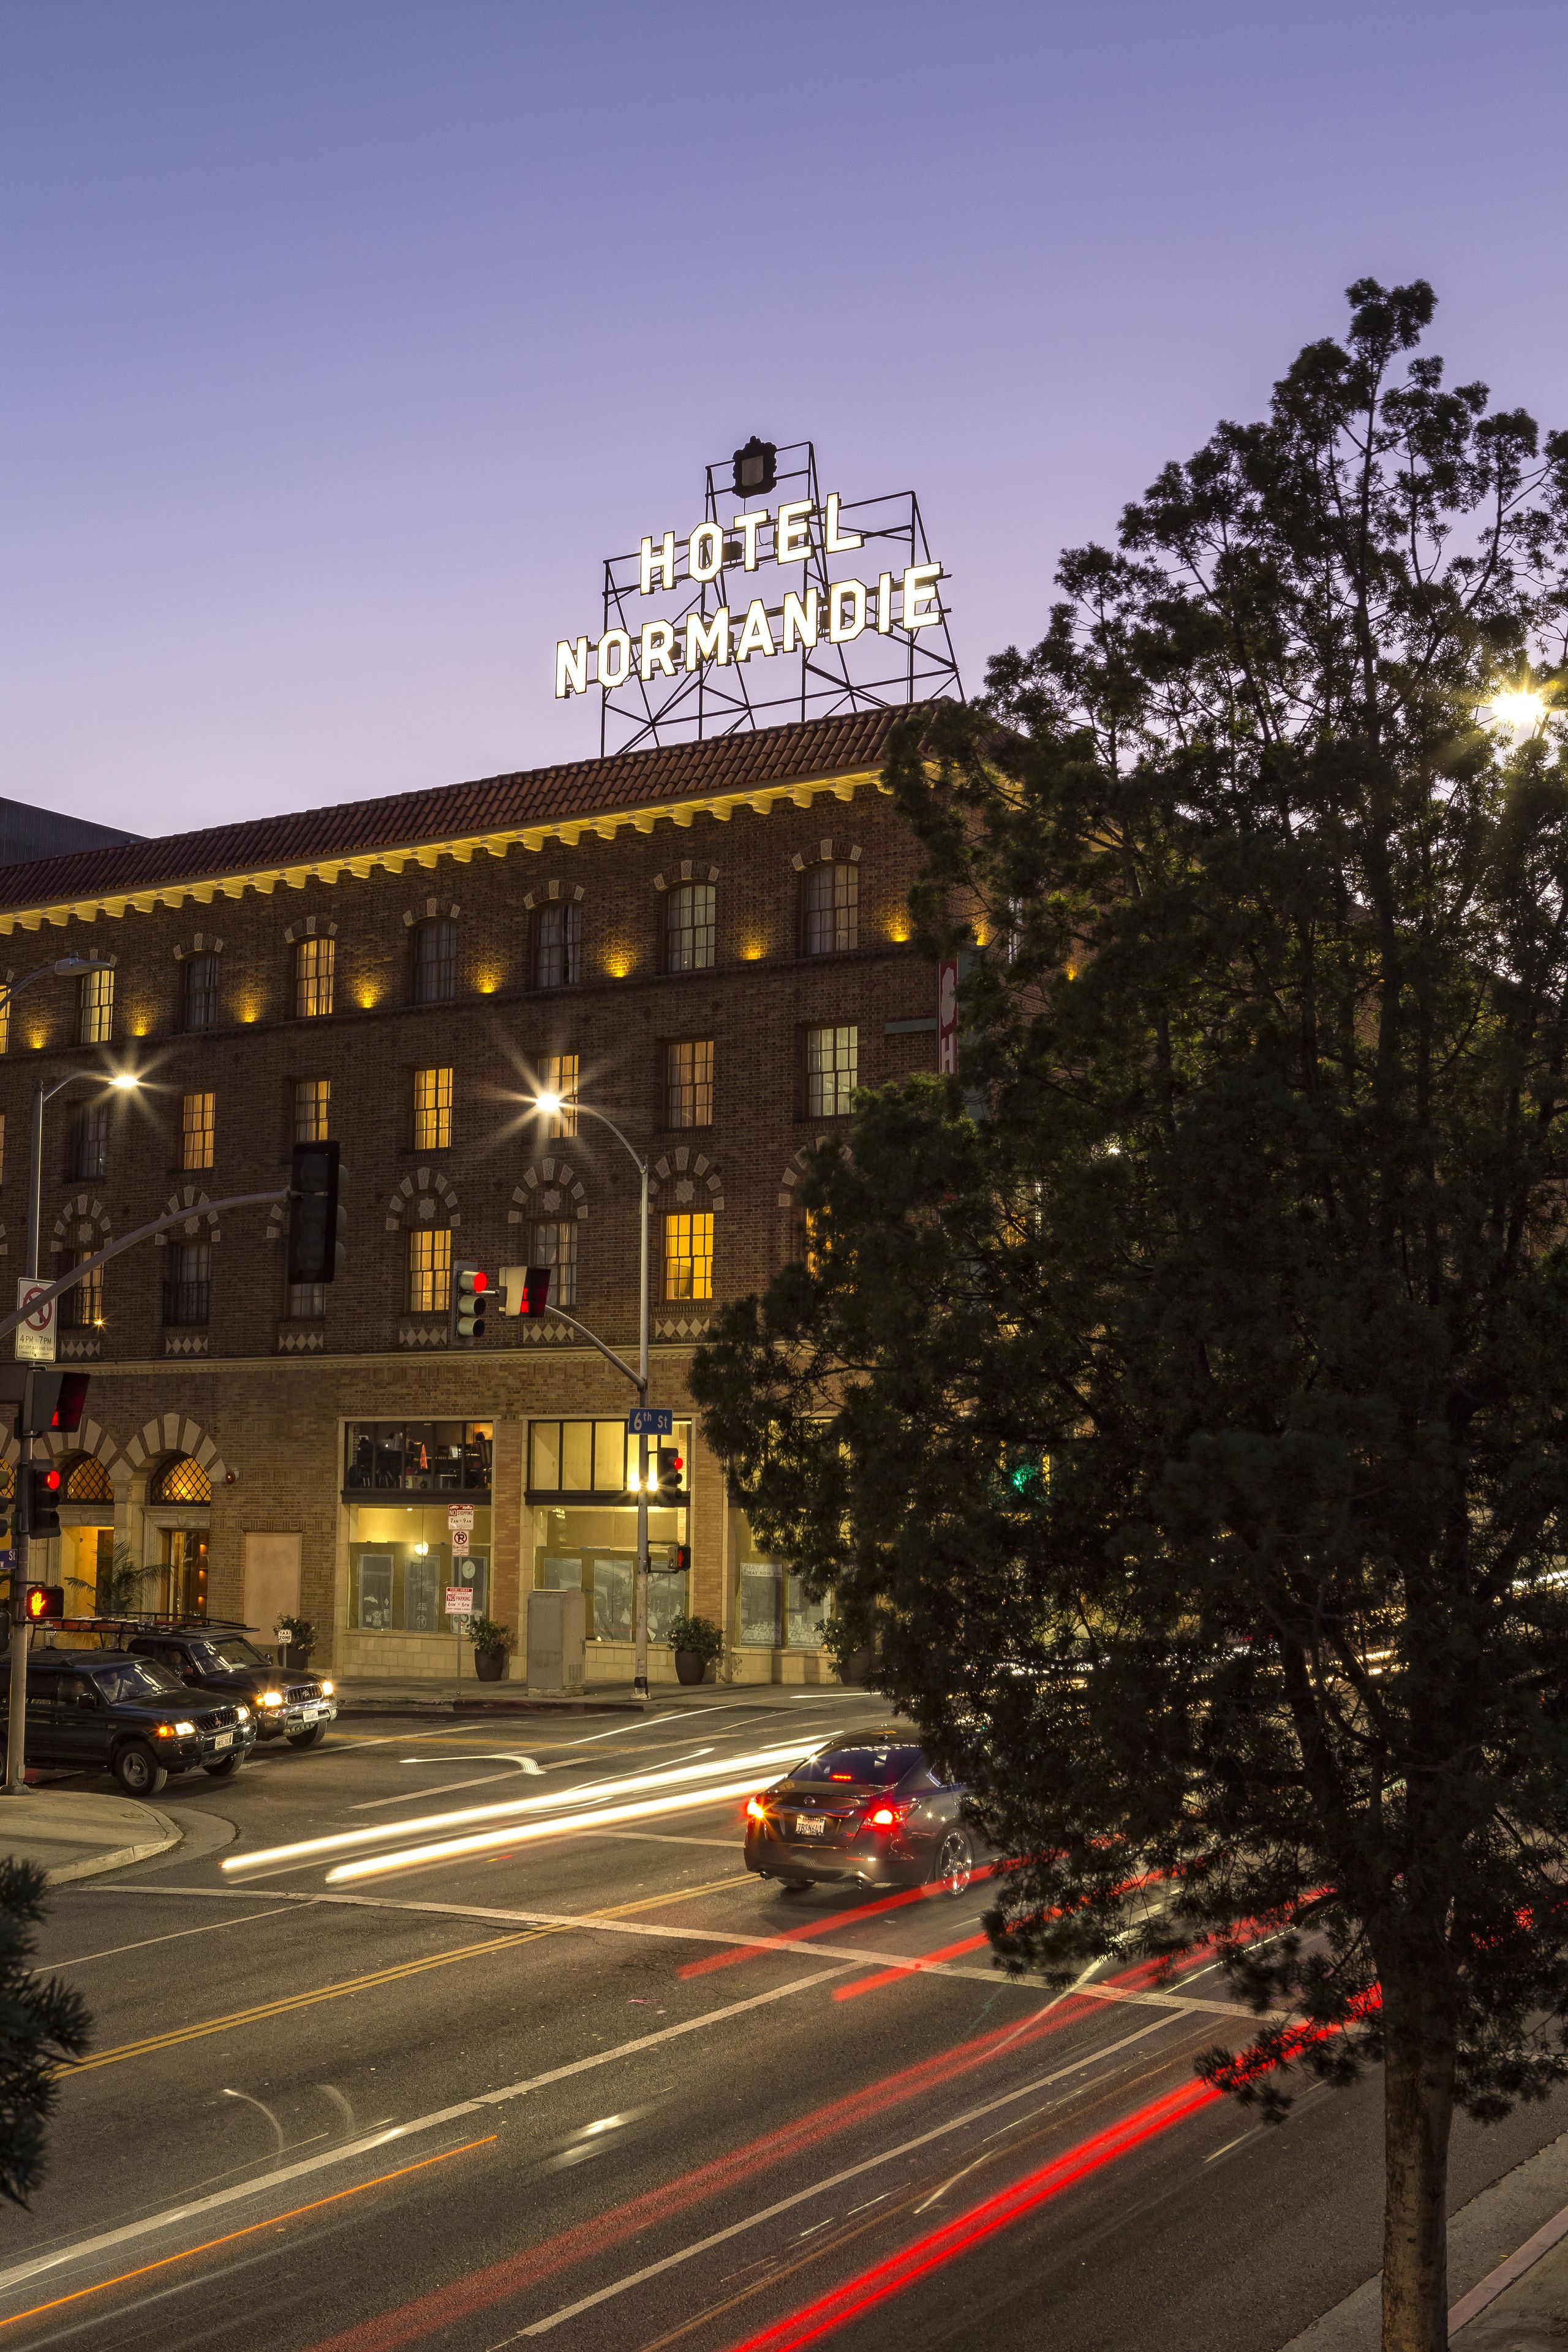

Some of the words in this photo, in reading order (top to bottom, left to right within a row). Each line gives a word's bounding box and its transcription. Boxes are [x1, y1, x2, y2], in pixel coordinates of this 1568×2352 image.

[640, 492, 864, 596] HOTEL
[555, 560, 944, 699] NORMANDIE
[633, 1411, 652, 1431] 6th
[657, 1415, 668, 1429] St
[9, 1550, 15, 1561] St
